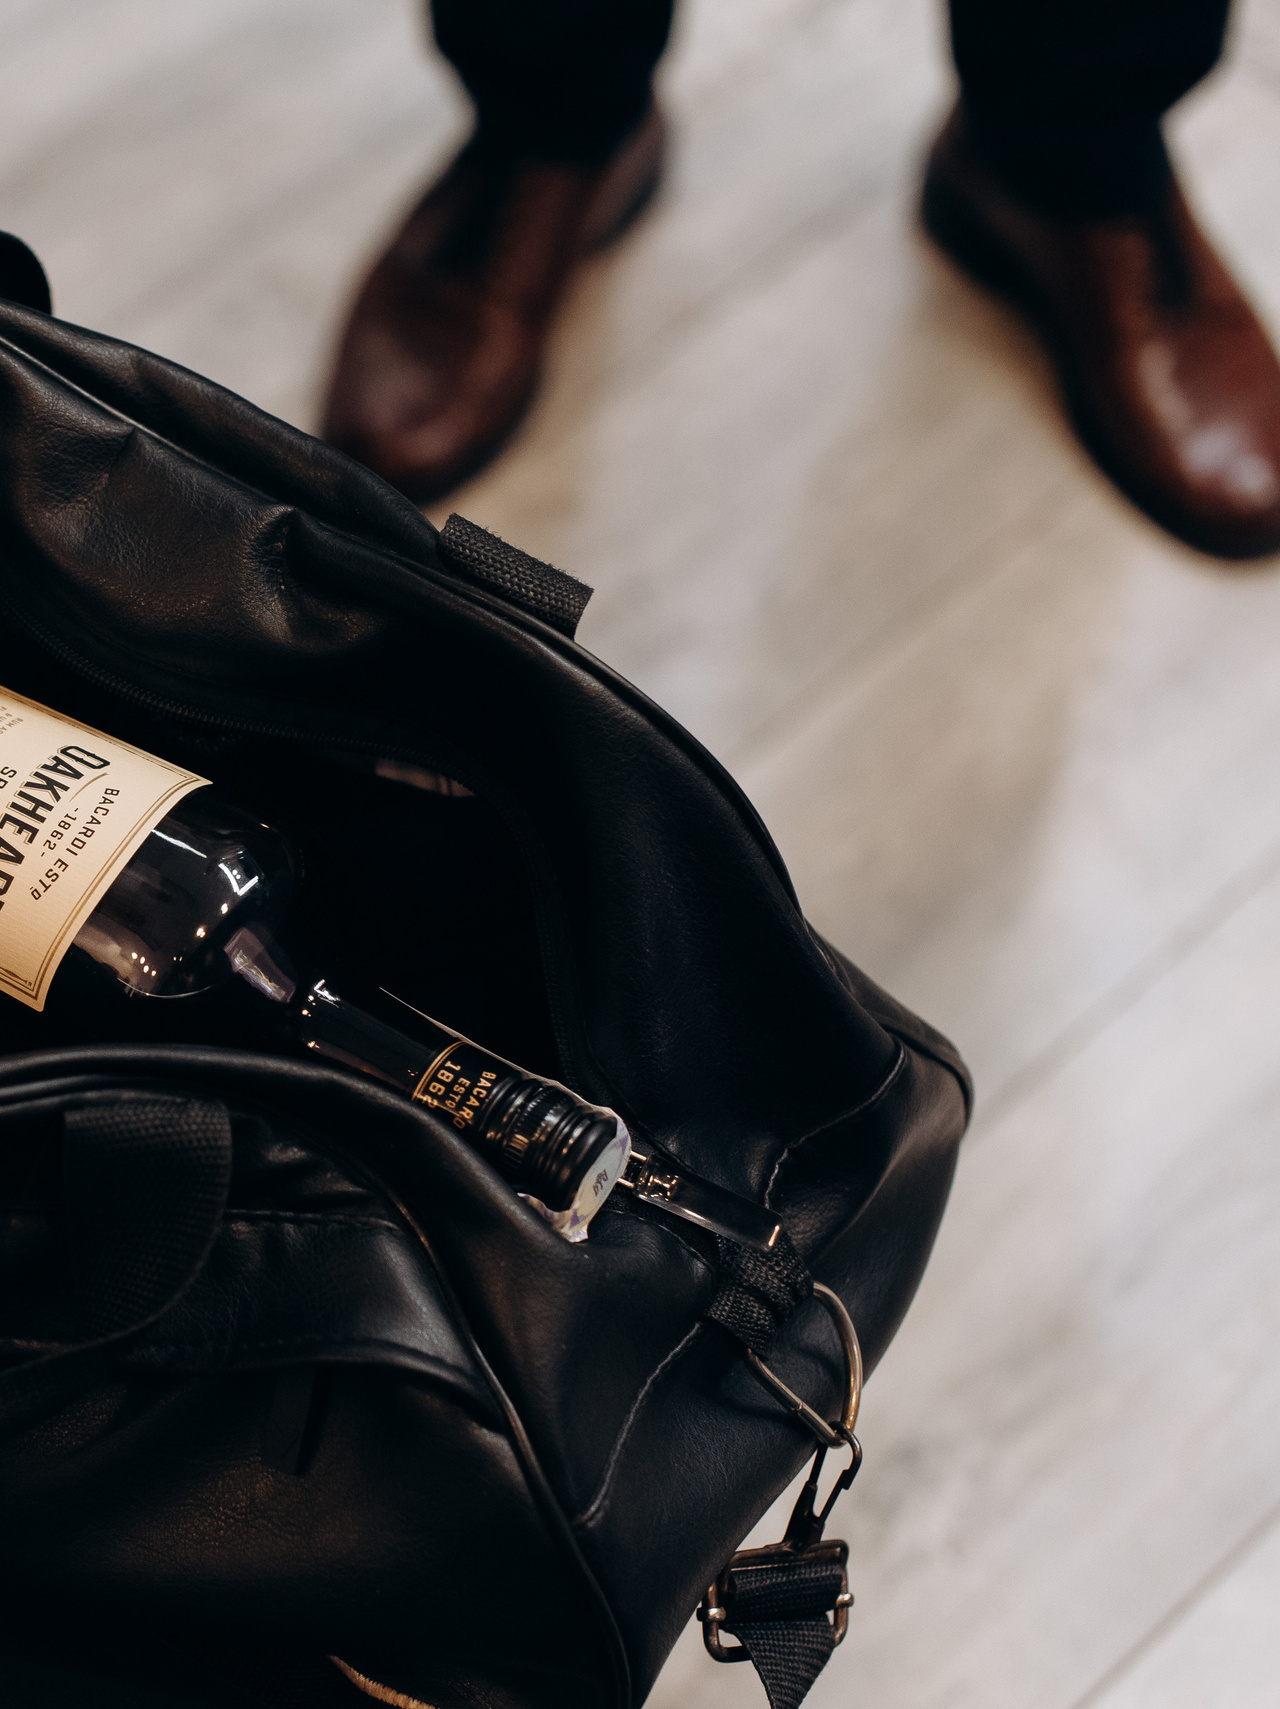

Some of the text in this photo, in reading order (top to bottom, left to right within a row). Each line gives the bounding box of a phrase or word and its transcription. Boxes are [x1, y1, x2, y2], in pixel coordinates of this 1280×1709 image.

[5, 716, 23, 728] RUM
[64, 785, 119, 857] BACARDI
[421, 1059, 461, 1109] 1862
